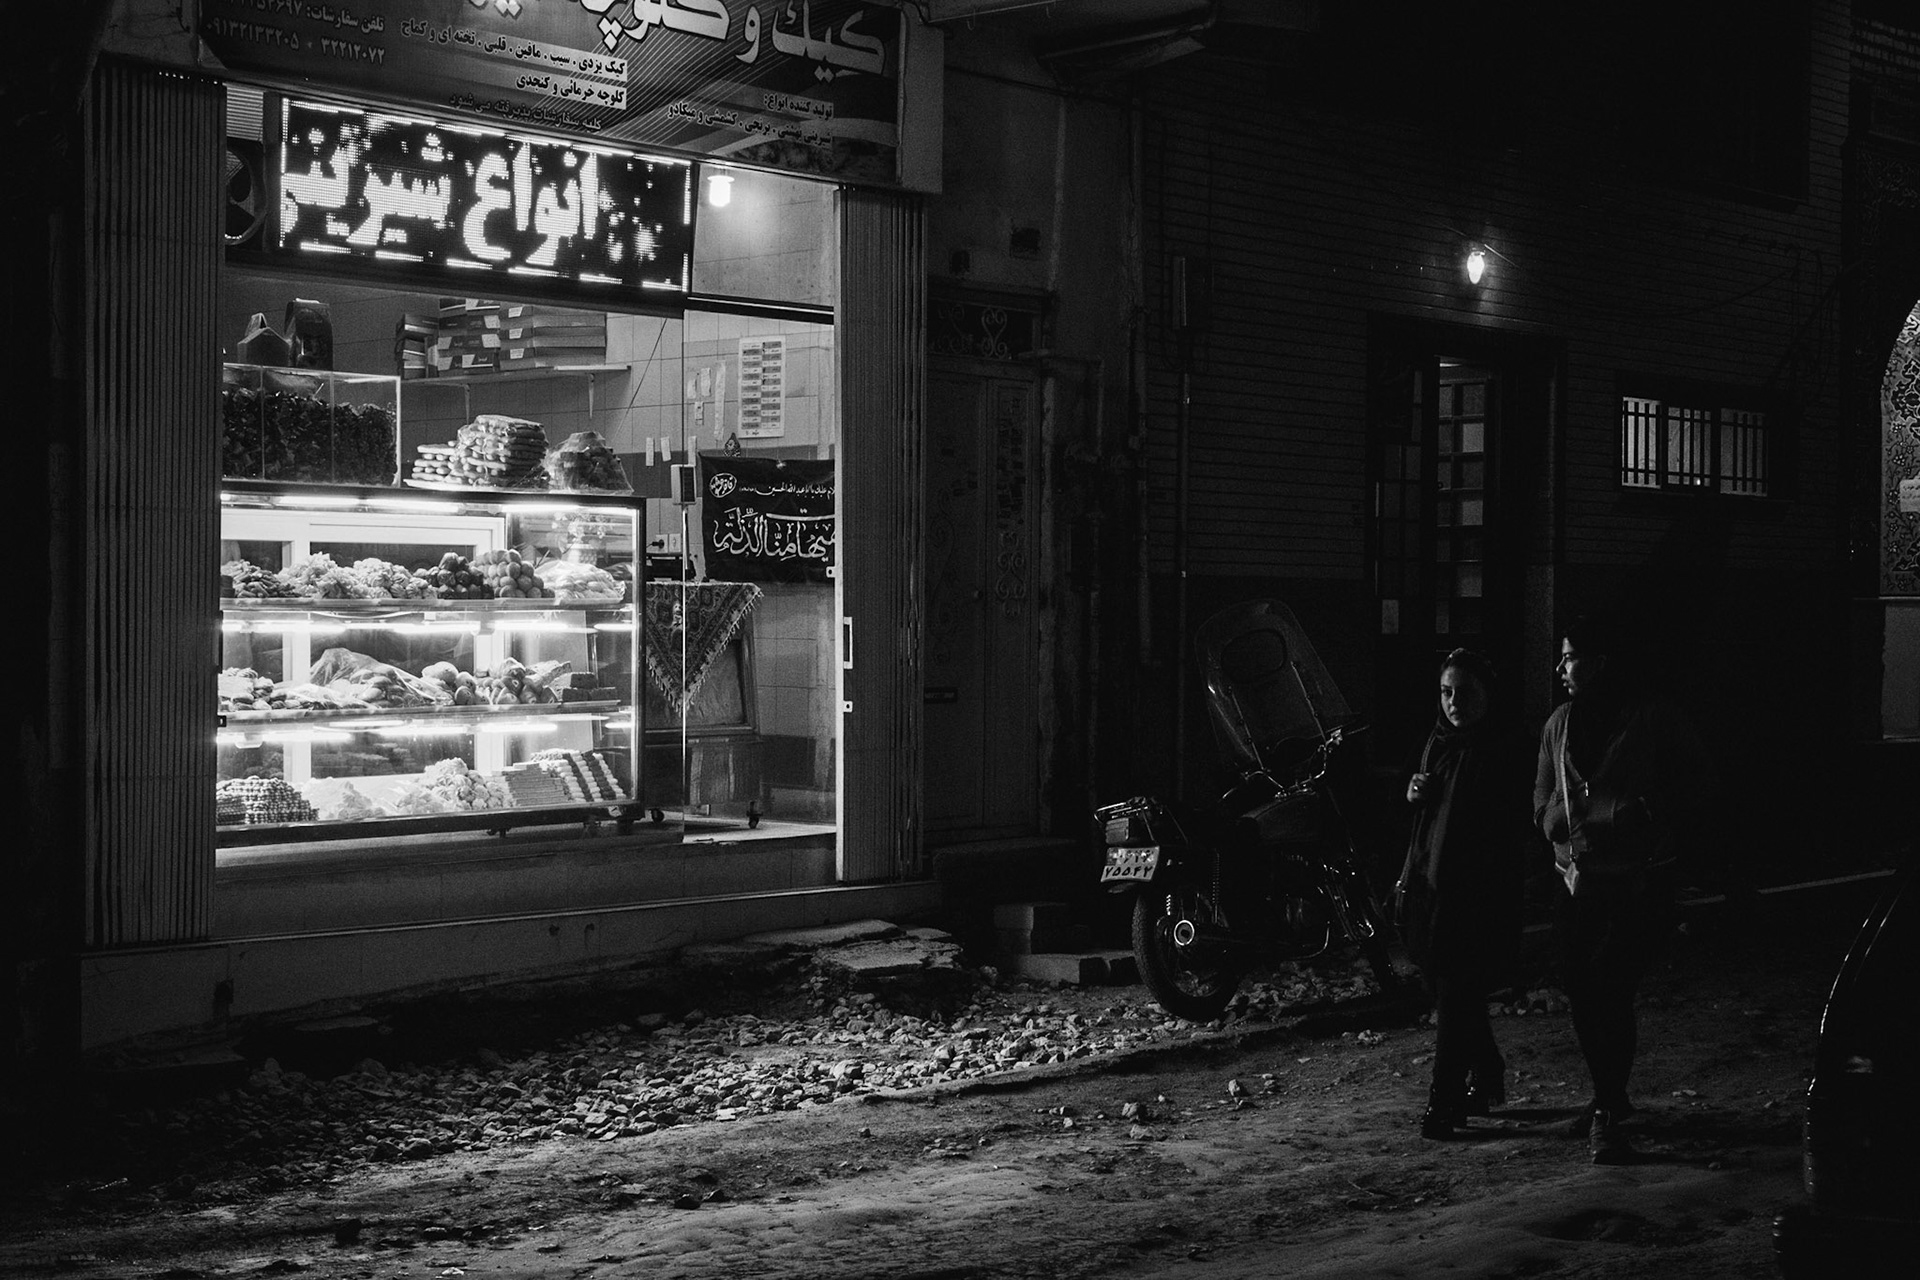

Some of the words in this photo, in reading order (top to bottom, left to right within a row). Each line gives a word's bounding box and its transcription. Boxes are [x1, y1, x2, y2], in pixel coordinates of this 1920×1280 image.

[306, 5, 359, 29] سفارشات:
[361, 15, 385, 33] تلفن
[401, 18, 427, 36] کماج
[429, 28, 436, 42] و
[438, 27, 451, 43] ای
[735, 5, 762, 64] و
[454, 30, 475, 45] تخته
[484, 36, 506, 53] قلبی
[515, 43, 541, 59] مافین
[549, 54, 570, 67] سیب
[578, 57, 602, 74] یزدی
[605, 59, 625, 75] کیک
[516, 75, 550, 91] کنجدی
[552, 83, 558, 95] و
[450, 92, 474, 110] شود
[597, 89, 625, 106] کلوچه
[764, 94, 788, 111] انواع:
[475, 101, 490, 113] می
[494, 99, 531, 122] پذیرفته
[669, 102, 696, 120] میکادو
[789, 99, 811, 114] کننده
[813, 104, 833, 120] تولید
[533, 107, 580, 126] سفارشات
[582, 117, 602, 132] کلیه
[698, 110, 704, 123] و
[706, 110, 737, 125] کشمشی
[744, 119, 770, 135] برنجی
[803, 131, 832, 147] شیرینی
[462, 141, 600, 266] انواع
